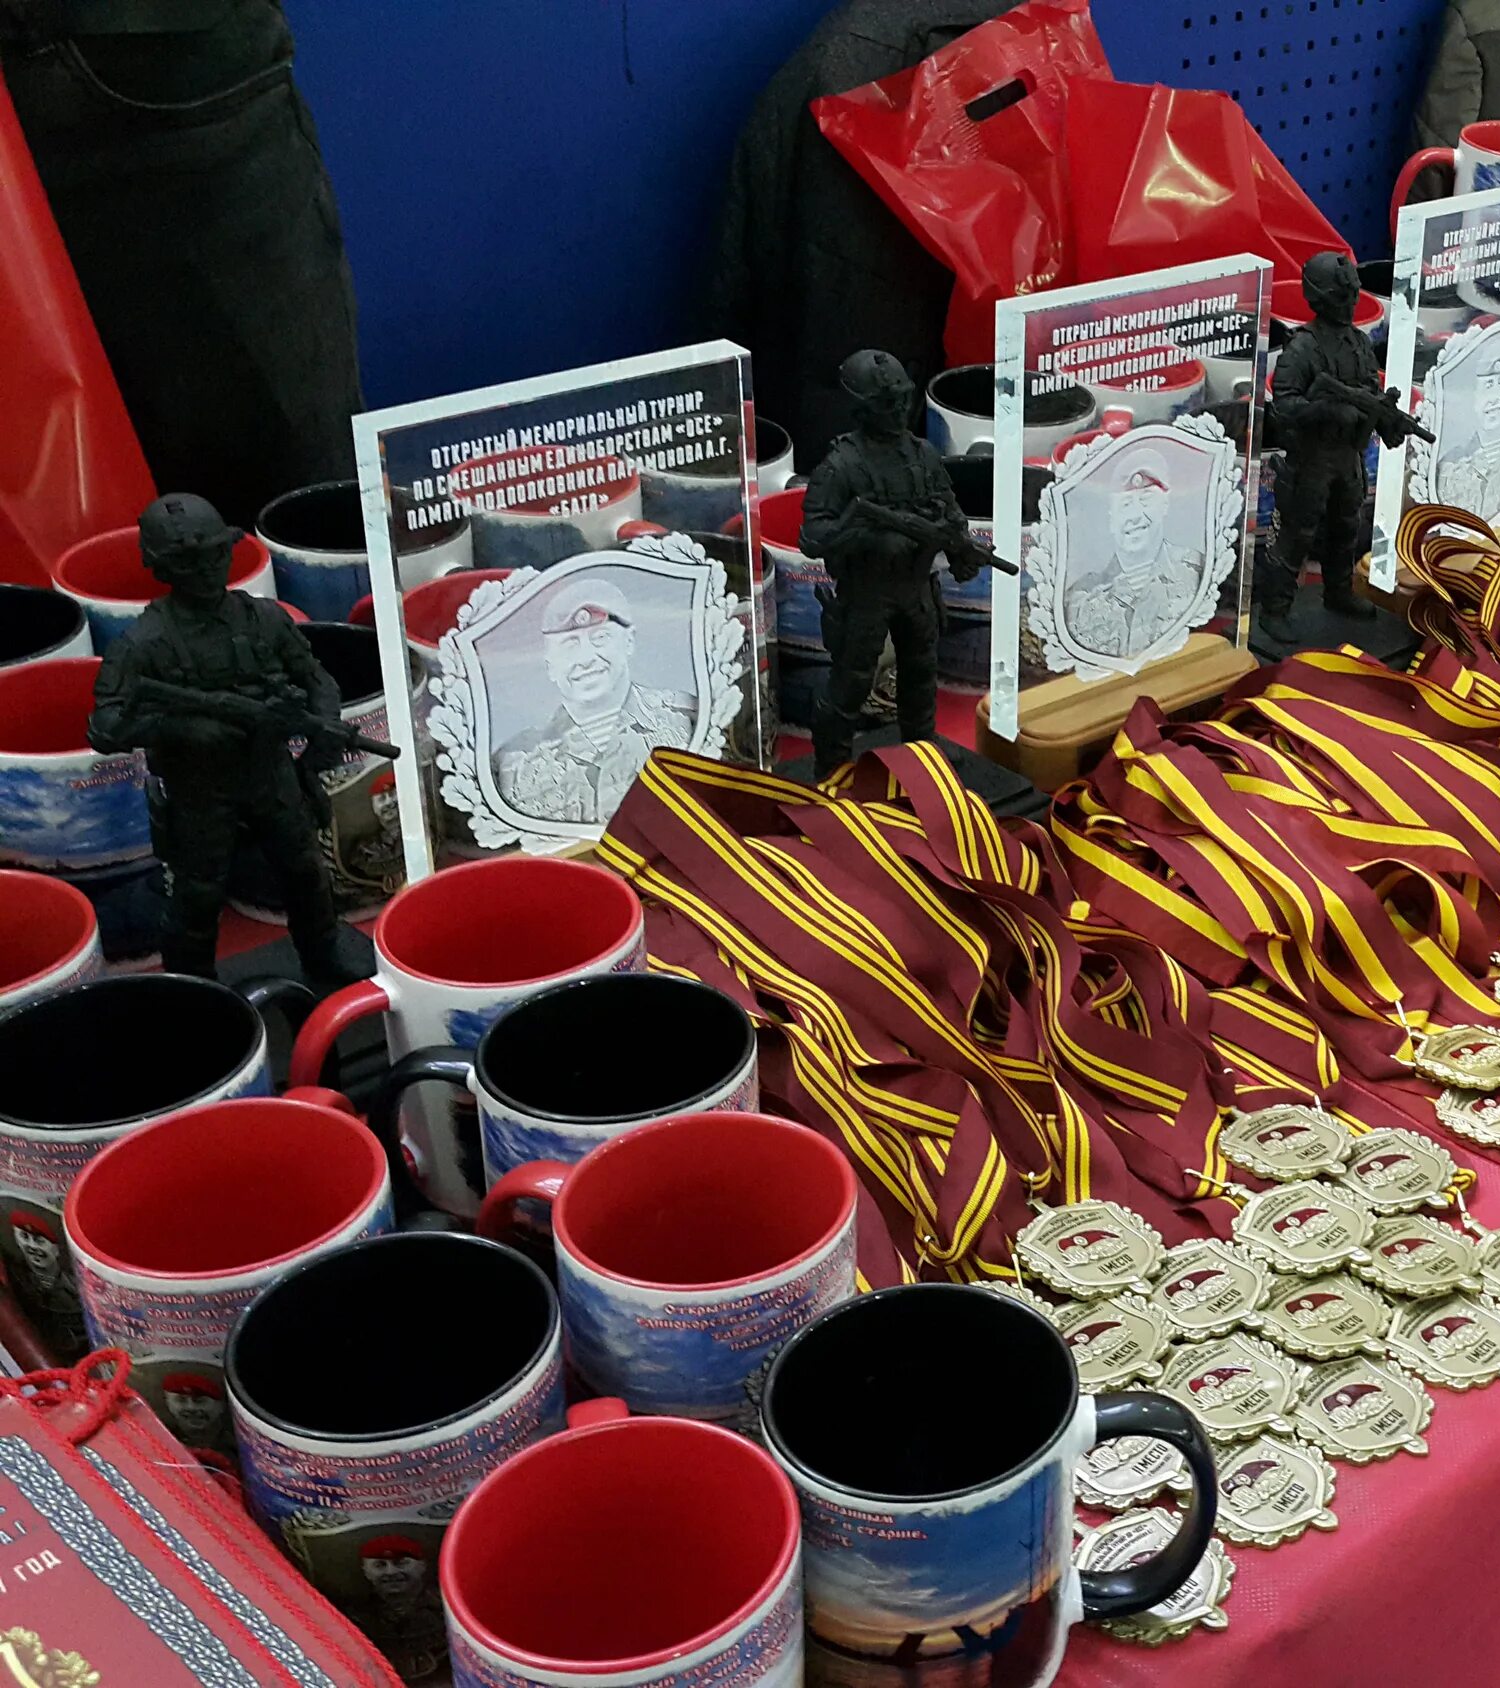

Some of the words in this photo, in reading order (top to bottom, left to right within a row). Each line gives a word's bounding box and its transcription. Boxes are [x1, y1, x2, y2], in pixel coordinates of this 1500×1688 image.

[1053, 316, 1111, 347] ОТКРЫТЫЙ
[1113, 298, 1200, 335] МЕМОРИАЛЬНЫЙ
[1201, 293, 1238, 316] ТУРНИР
[1038, 354, 1052, 372] ПО
[1053, 338, 1126, 368] СМЕШАННЫМ
[1127, 320, 1214, 353] ЕДИНОБОРСТВАМ
[1031, 371, 1076, 396] ПАМЯТИ
[1077, 352, 1166, 385] ПОДПОЛКОВНИКА
[1167, 337, 1232, 367] ПАРАМОНОВА
[1125, 375, 1167, 394] «БАТЯ»
[431, 428, 518, 469] ОТКРЫТЫЙ
[519, 400, 648, 451] МЕМОРИАЛЬНЫЙ
[649, 391, 704, 419] ТУРНИР
[413, 479, 434, 501] ПО
[436, 453, 543, 495] СМЕШАННЫМ
[545, 424, 673, 470] ЕДИНОБОРСТВАМ
[406, 497, 472, 531] ПАМЯТИ
[475, 466, 606, 511] ПОДПОЛКОВНИКА
[607, 442, 704, 482] ПАРАМОНОВА
[706, 436, 733, 459] А.Г.
[549, 493, 609, 518] «БАТЯ»
[1301, 1143, 1327, 1160] МЕСТО
[1404, 1174, 1429, 1191] МЕСТО
[1323, 1226, 1348, 1246] МЕСТО
[1106, 1254, 1134, 1272] МЕСТО
[664, 1297, 753, 1317] Открытый
[1214, 1289, 1242, 1311] МЕСТО
[1338, 1314, 1363, 1332] МЕСТО
[1111, 1340, 1139, 1364] МЕСТО
[1473, 1338, 1497, 1361] МЕСТО
[1241, 1390, 1270, 1412] МЕСТО
[1378, 1408, 1404, 1433] МЕСТО
[1137, 1443, 1168, 1469] МЕСТО
[1279, 1482, 1306, 1510] МЕСТО
[857, 1525, 928, 1541] старше.
[13, 1549, 62, 1582] ГОД
